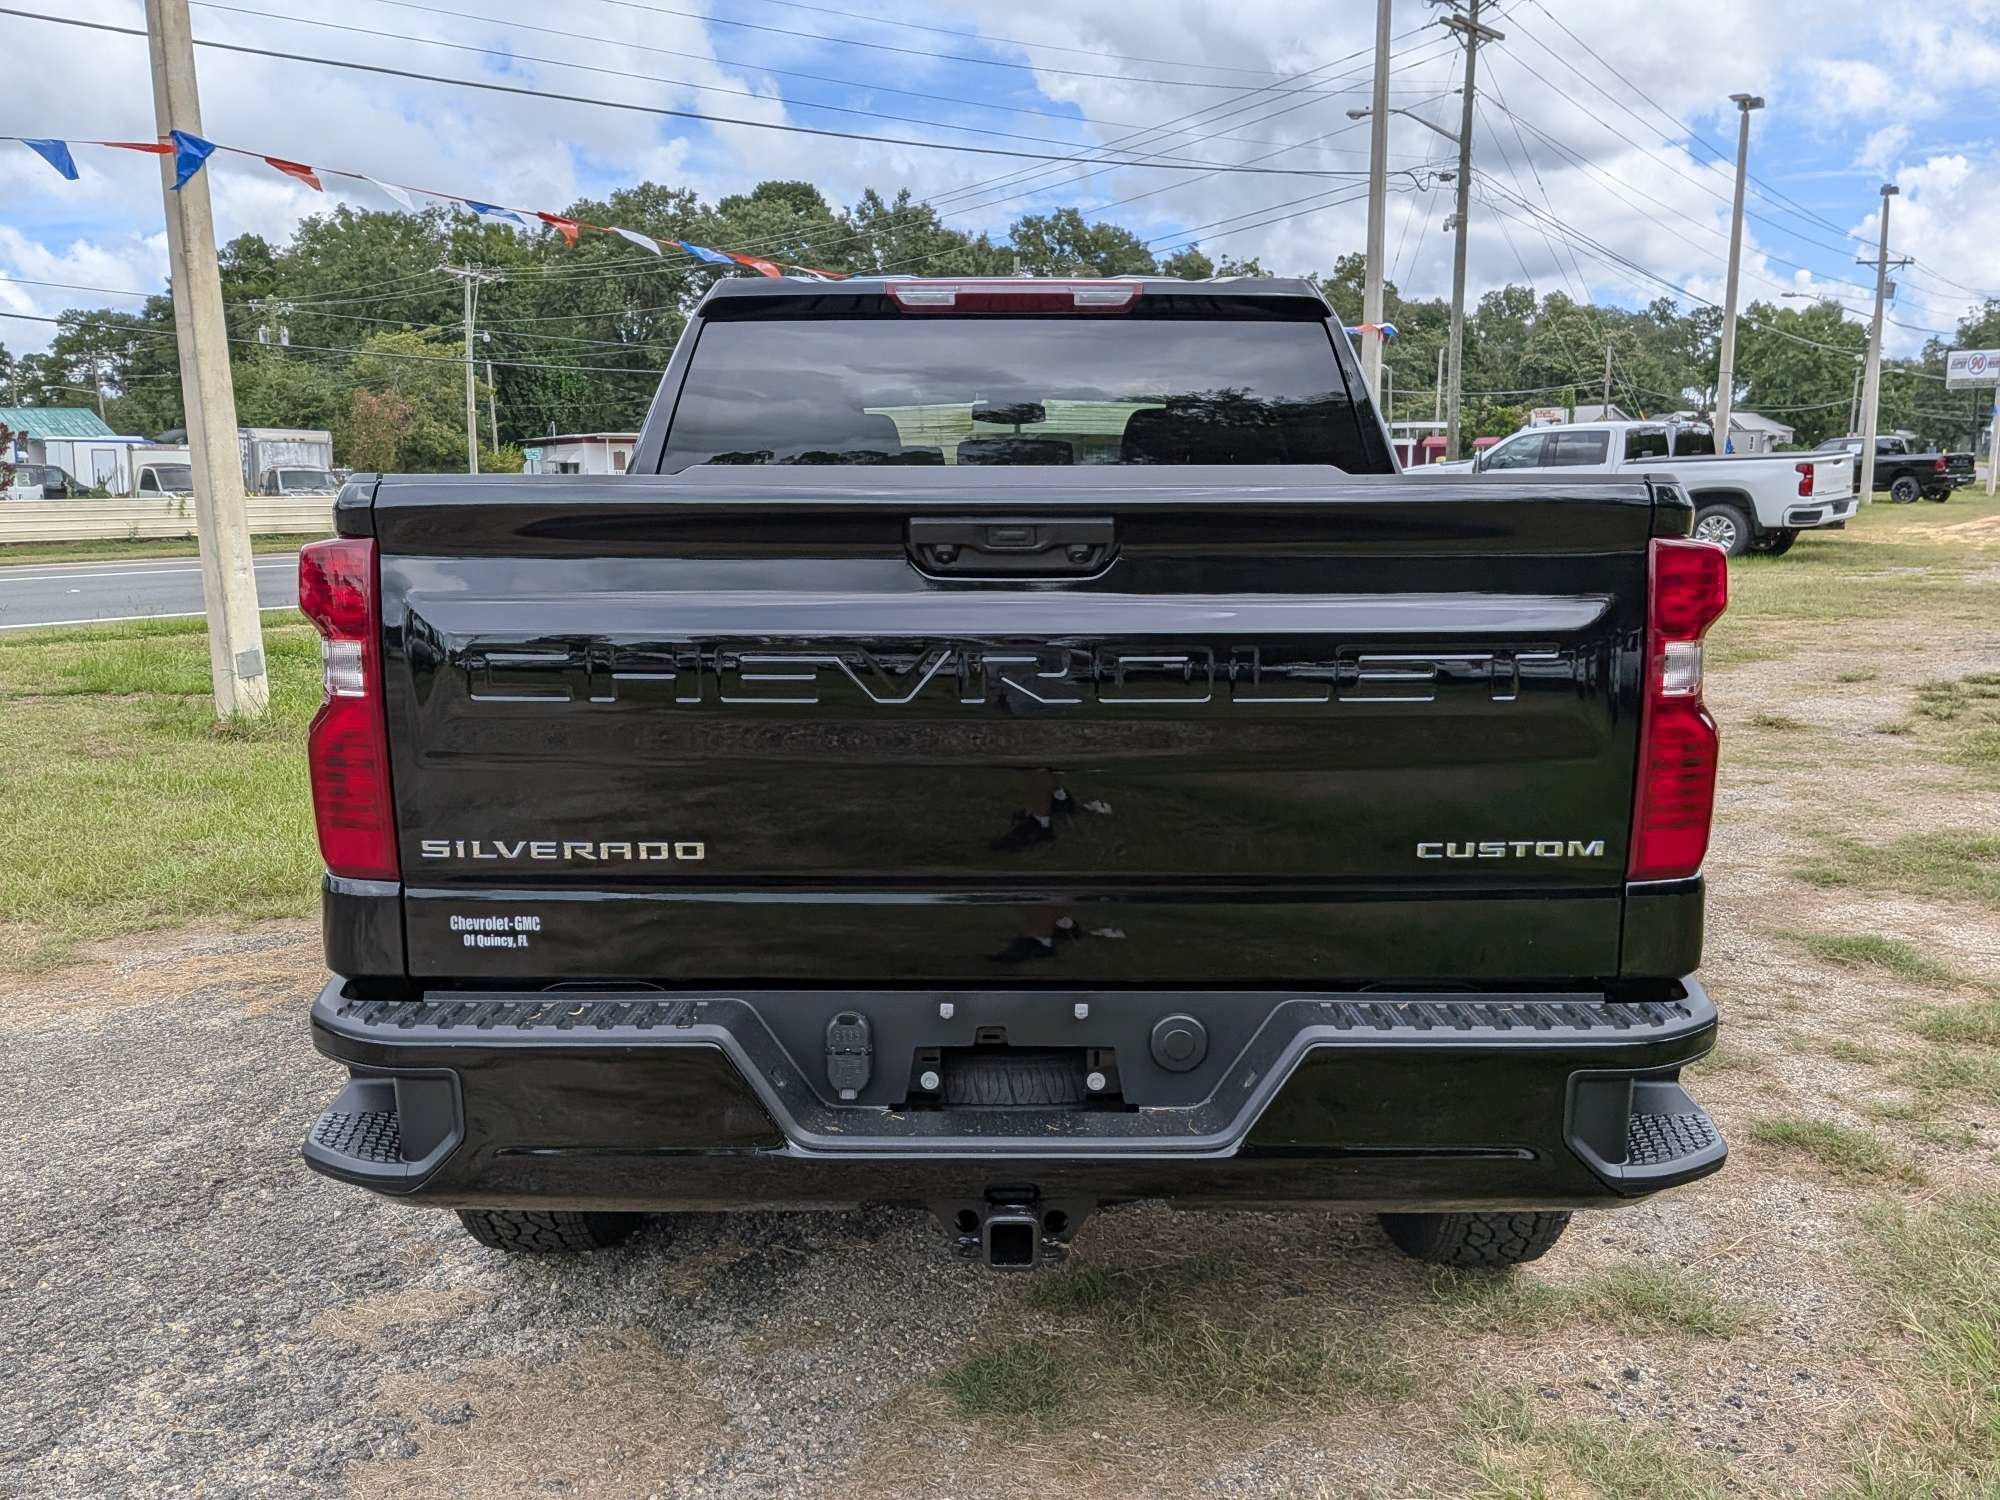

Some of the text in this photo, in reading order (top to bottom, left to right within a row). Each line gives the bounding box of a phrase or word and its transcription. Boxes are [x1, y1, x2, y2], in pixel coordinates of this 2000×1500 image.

[465, 643, 1560, 703] CHEVROLET
[420, 839, 706, 861] SILVERADO
[1416, 840, 1605, 858] CUSTOM
[449, 915, 541, 931] Chevrolet-GMC
[463, 934, 529, 948] Of Quincy, FL
